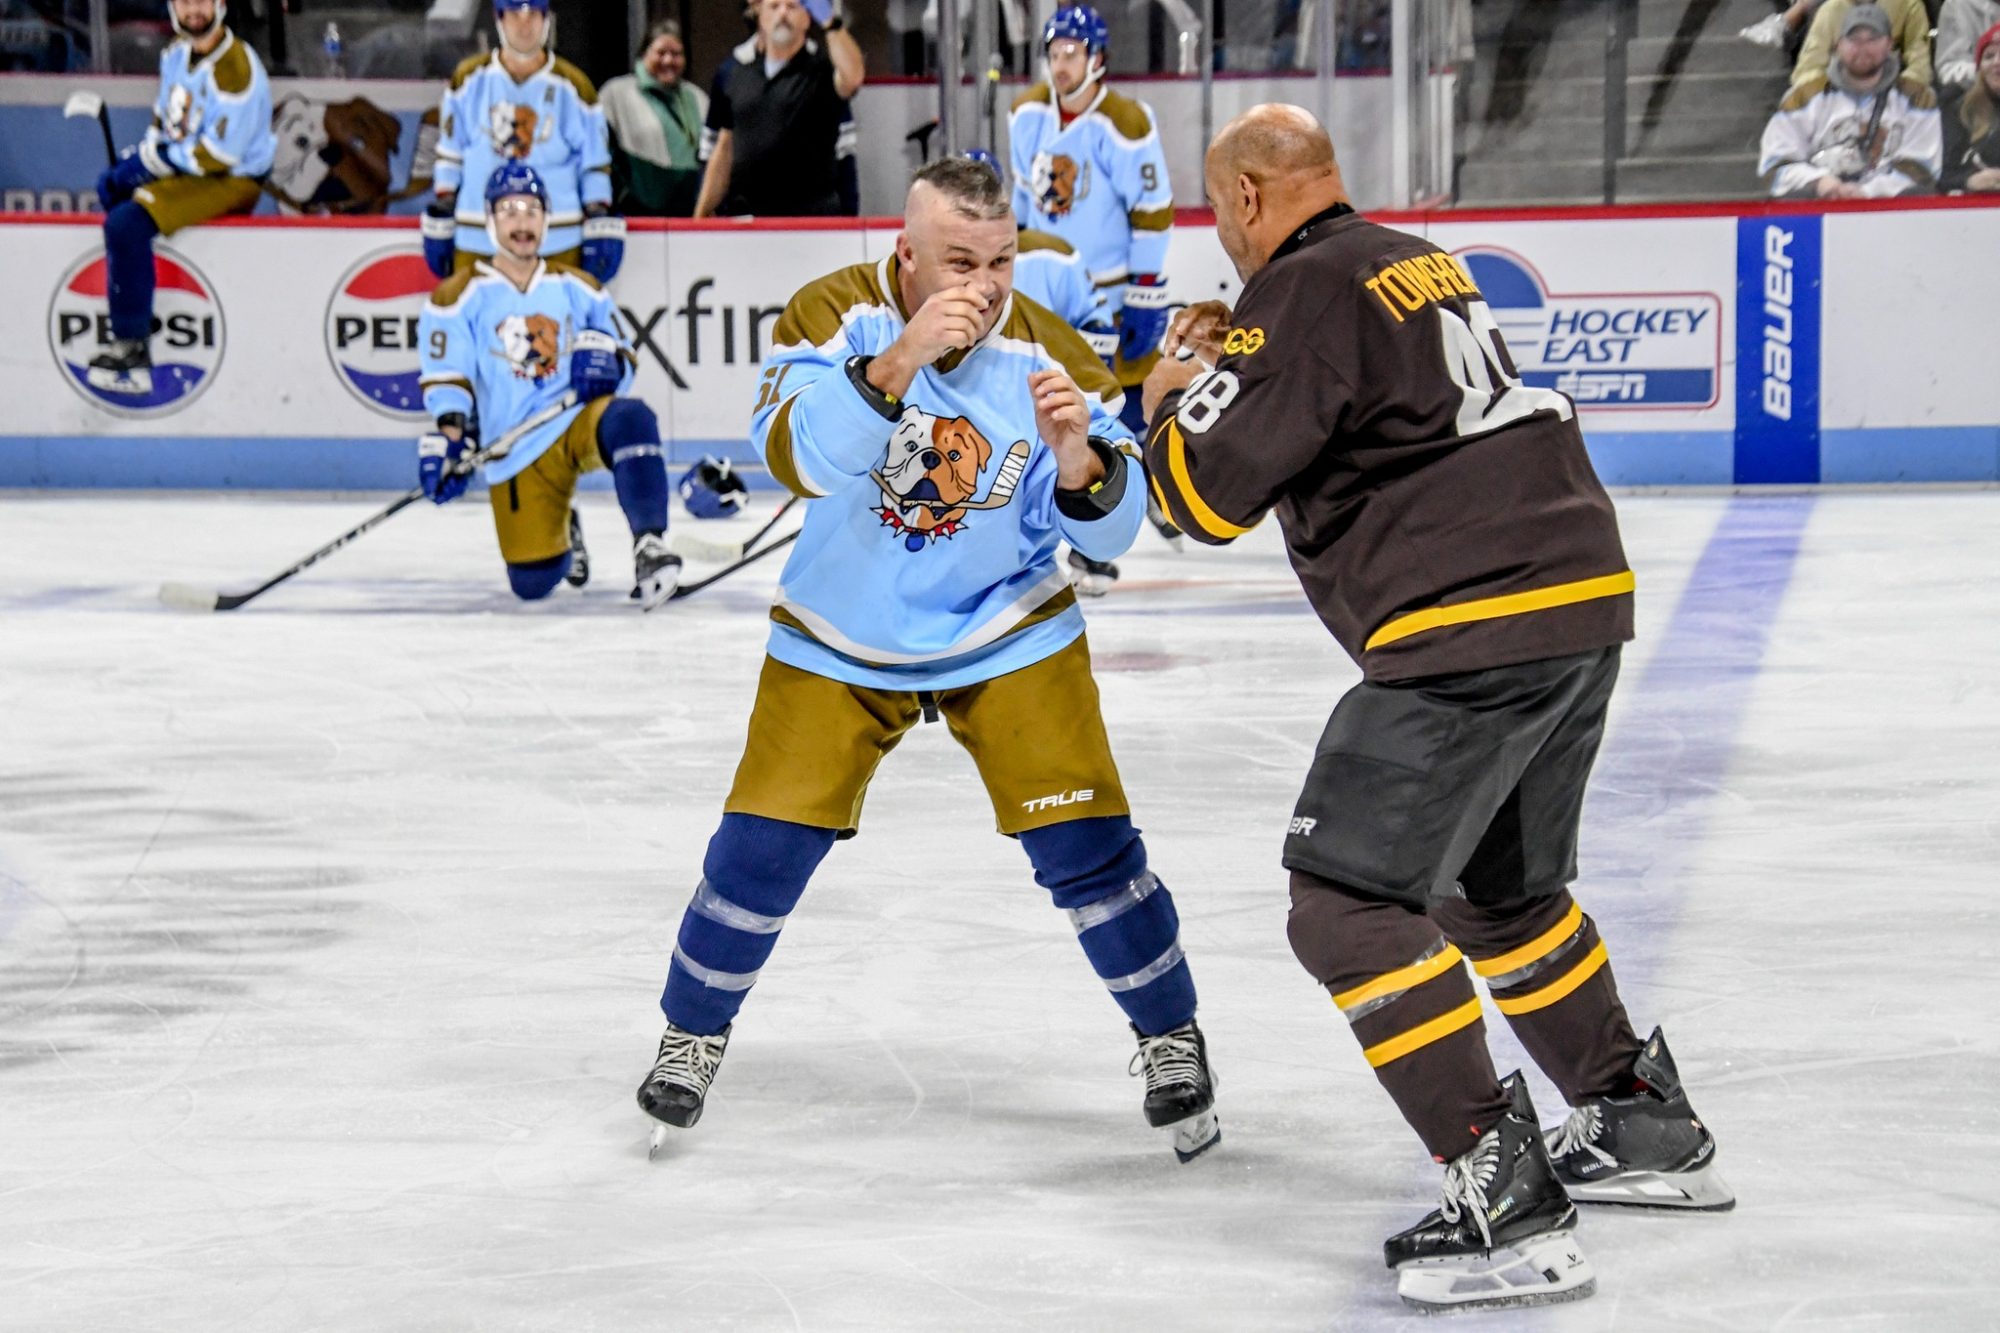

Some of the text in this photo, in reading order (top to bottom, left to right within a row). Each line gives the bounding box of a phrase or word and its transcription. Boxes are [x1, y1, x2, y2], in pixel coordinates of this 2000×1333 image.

[1139, 163, 1159, 192] 9
[1549, 308, 1710, 335] HOCKEY
[429, 330, 448, 360] 9
[1542, 337, 1640, 363] EAST
[1556, 370, 1647, 401] ESPN
[1022, 788, 1094, 813] TRUE
